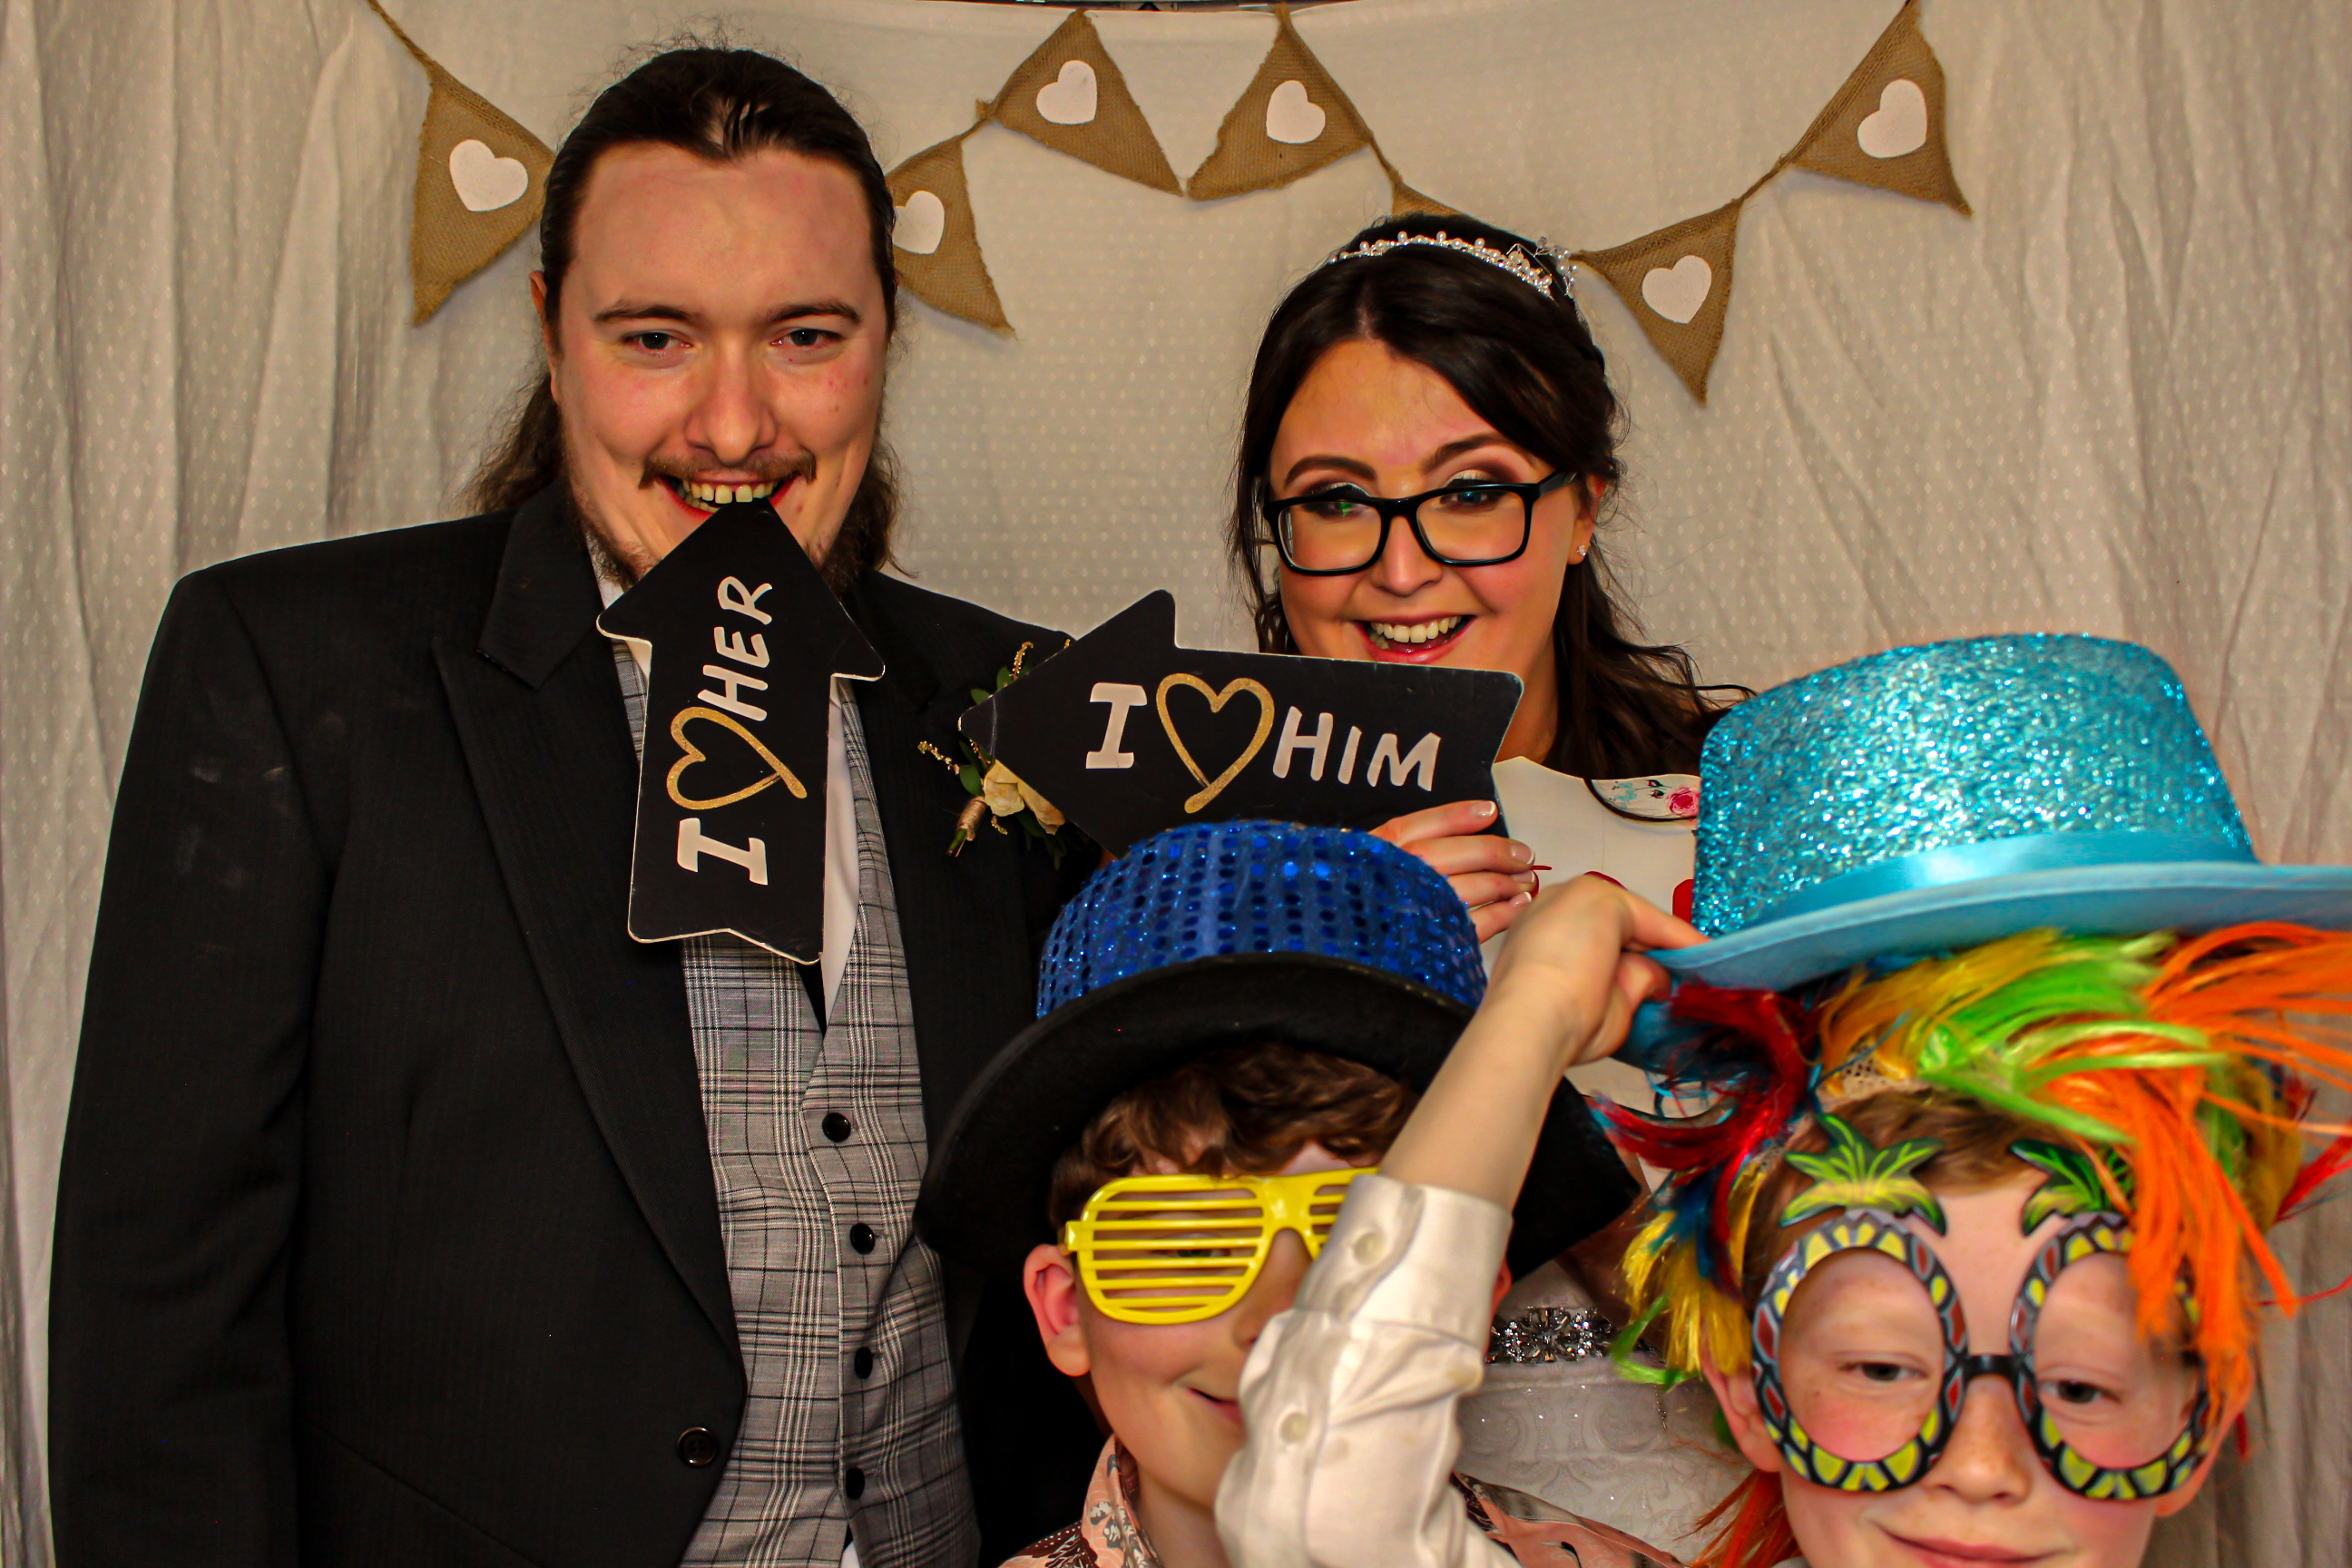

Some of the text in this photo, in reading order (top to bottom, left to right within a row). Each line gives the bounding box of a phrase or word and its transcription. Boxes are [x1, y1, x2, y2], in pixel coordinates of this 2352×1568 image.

[676, 575, 773, 886] I HER
[1085, 682, 1441, 792] I HIM
